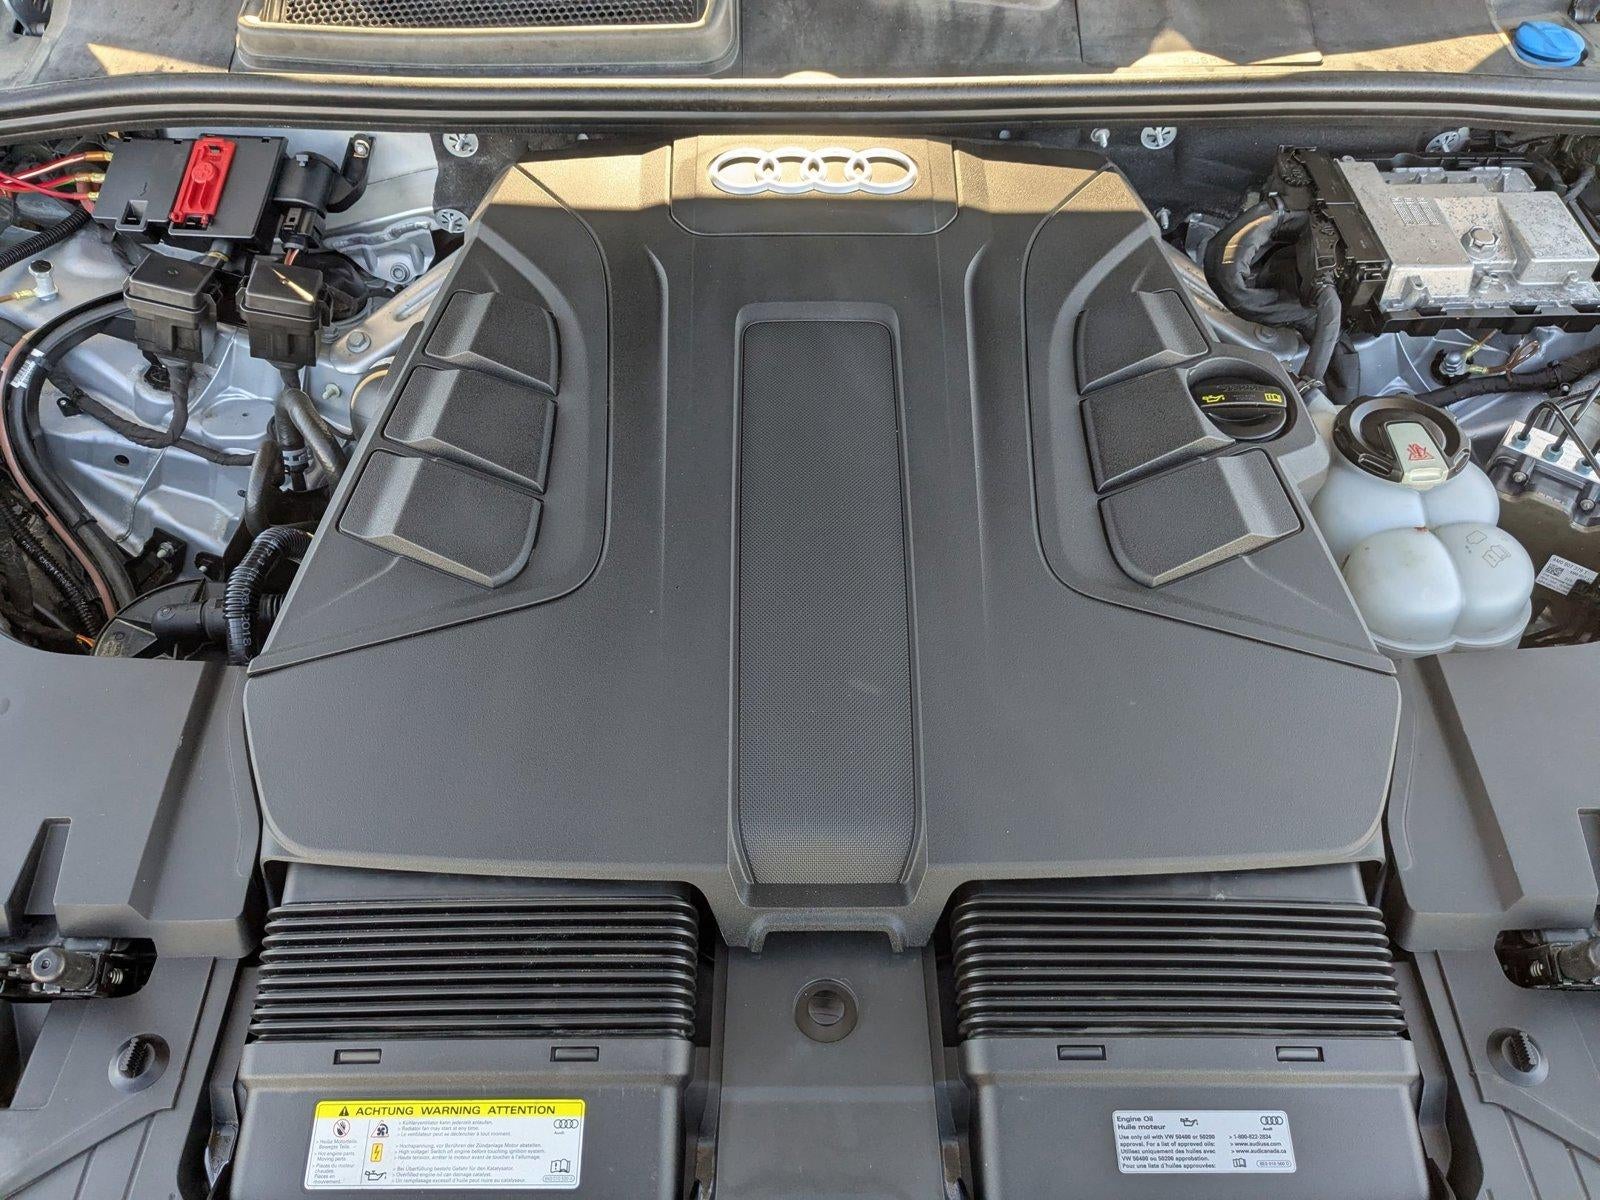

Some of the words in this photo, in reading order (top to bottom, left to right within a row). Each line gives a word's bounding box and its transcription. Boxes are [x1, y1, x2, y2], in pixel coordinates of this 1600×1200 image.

[355, 1106, 414, 1116] ACHTUNG
[421, 1106, 481, 1115] WARNING
[488, 1105, 556, 1115] ATTENTION
